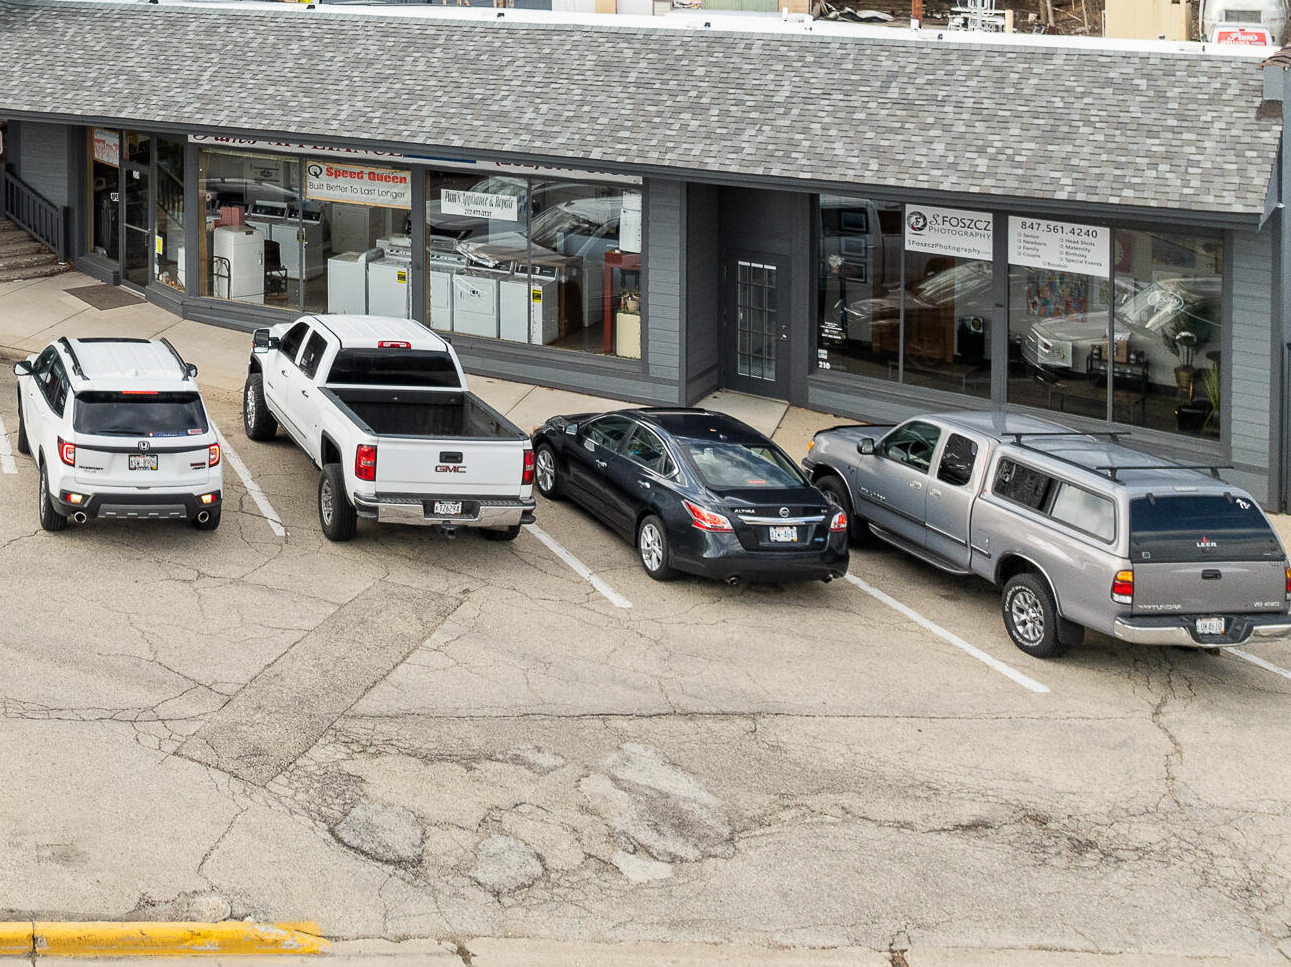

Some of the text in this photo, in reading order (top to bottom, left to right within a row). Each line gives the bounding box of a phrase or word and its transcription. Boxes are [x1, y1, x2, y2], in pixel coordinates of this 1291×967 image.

[325, 166, 364, 180] Speed
[368, 171, 408, 184] Queen
[309, 182, 406, 199] Built Better To Last Longer
[461, 192, 488, 207] Appliance
[495, 196, 514, 210] Repair
[928, 225, 991, 239] PHOTOGRAPHY
[1020, 220, 1098, 239] 847.561.4240
[1065, 245, 1091, 253] Maternity
[1065, 251, 1087, 259] Birthday
[818, 361, 831, 370] 210
[435, 465, 467, 473] GMC
